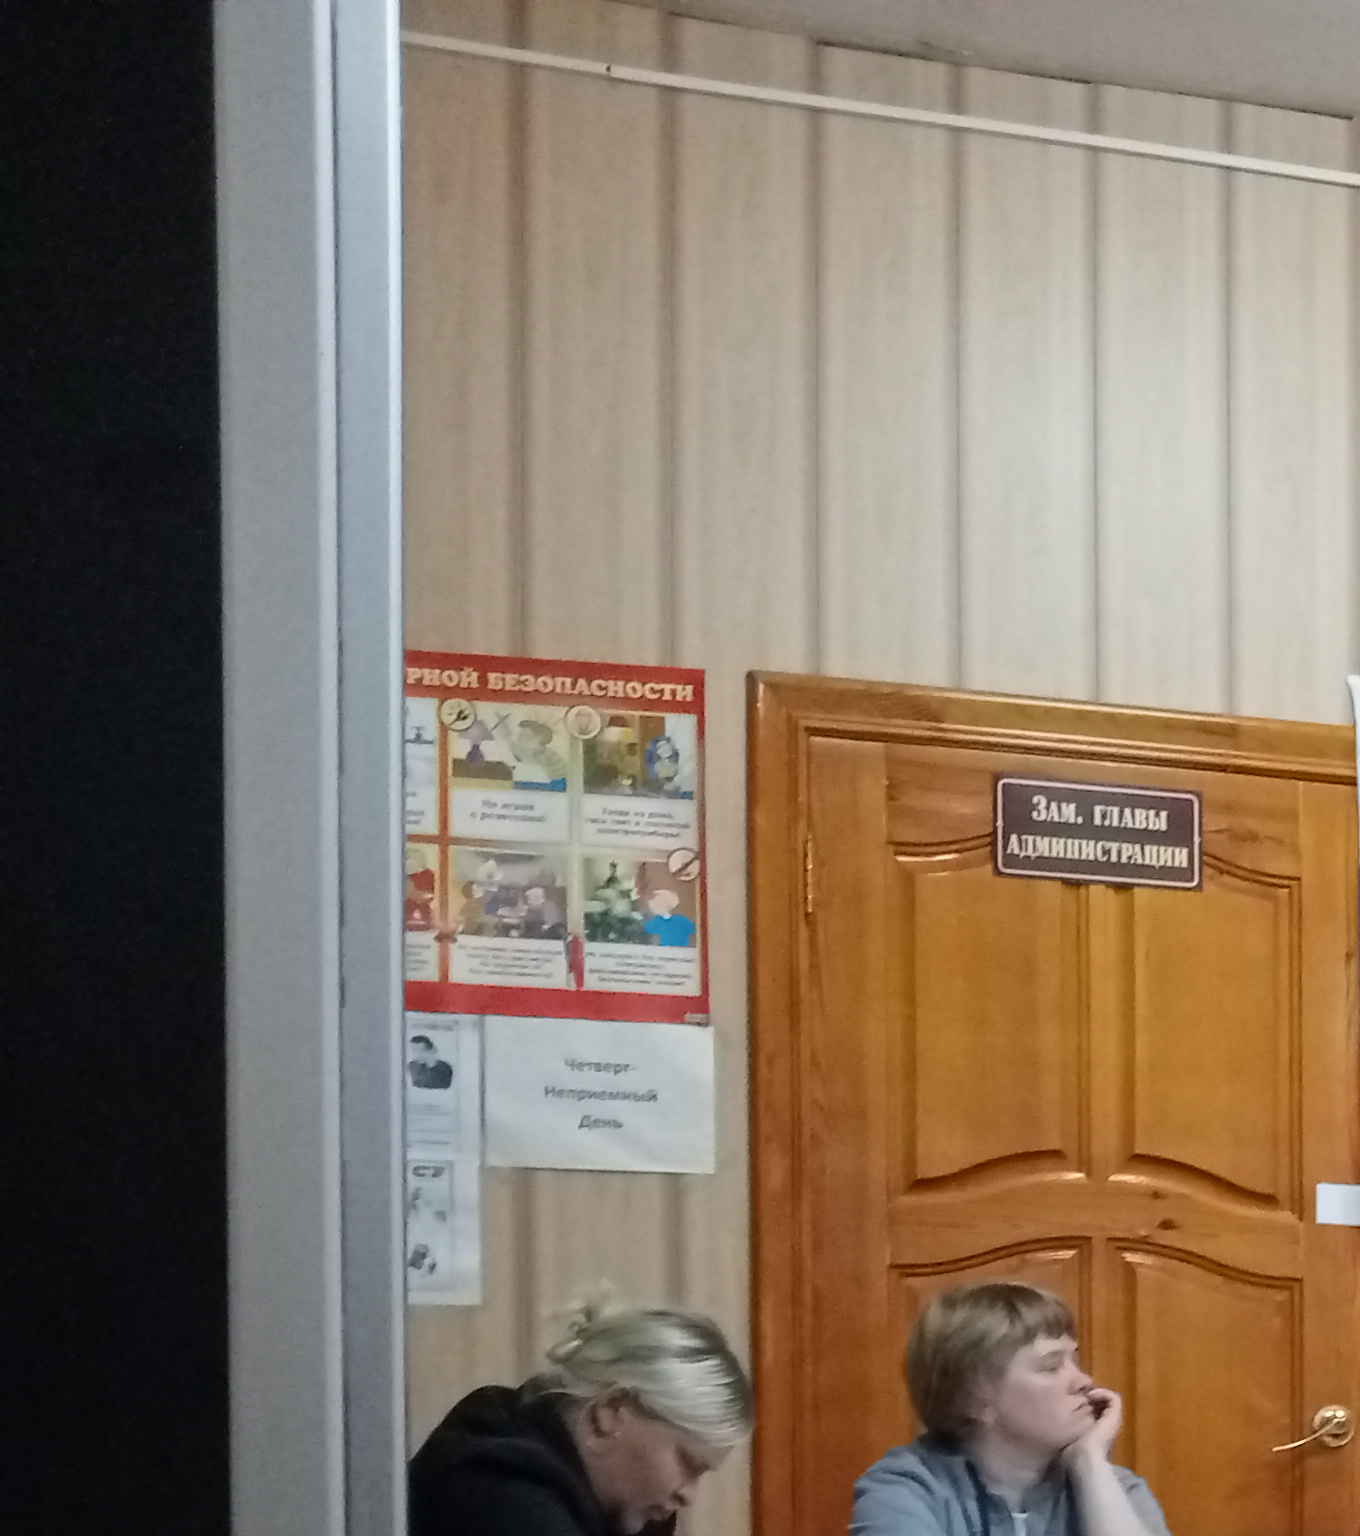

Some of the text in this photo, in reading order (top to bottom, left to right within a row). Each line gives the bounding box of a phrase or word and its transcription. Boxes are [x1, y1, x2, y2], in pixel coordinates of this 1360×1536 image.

[487, 671, 694, 702] БЕЗОПАСНОСТИ
[1006, 832, 1190, 868] АДМИНИСТРАЦИИ
[544, 1086, 657, 1102] Неприемный
[578, 1115, 621, 1129] День
